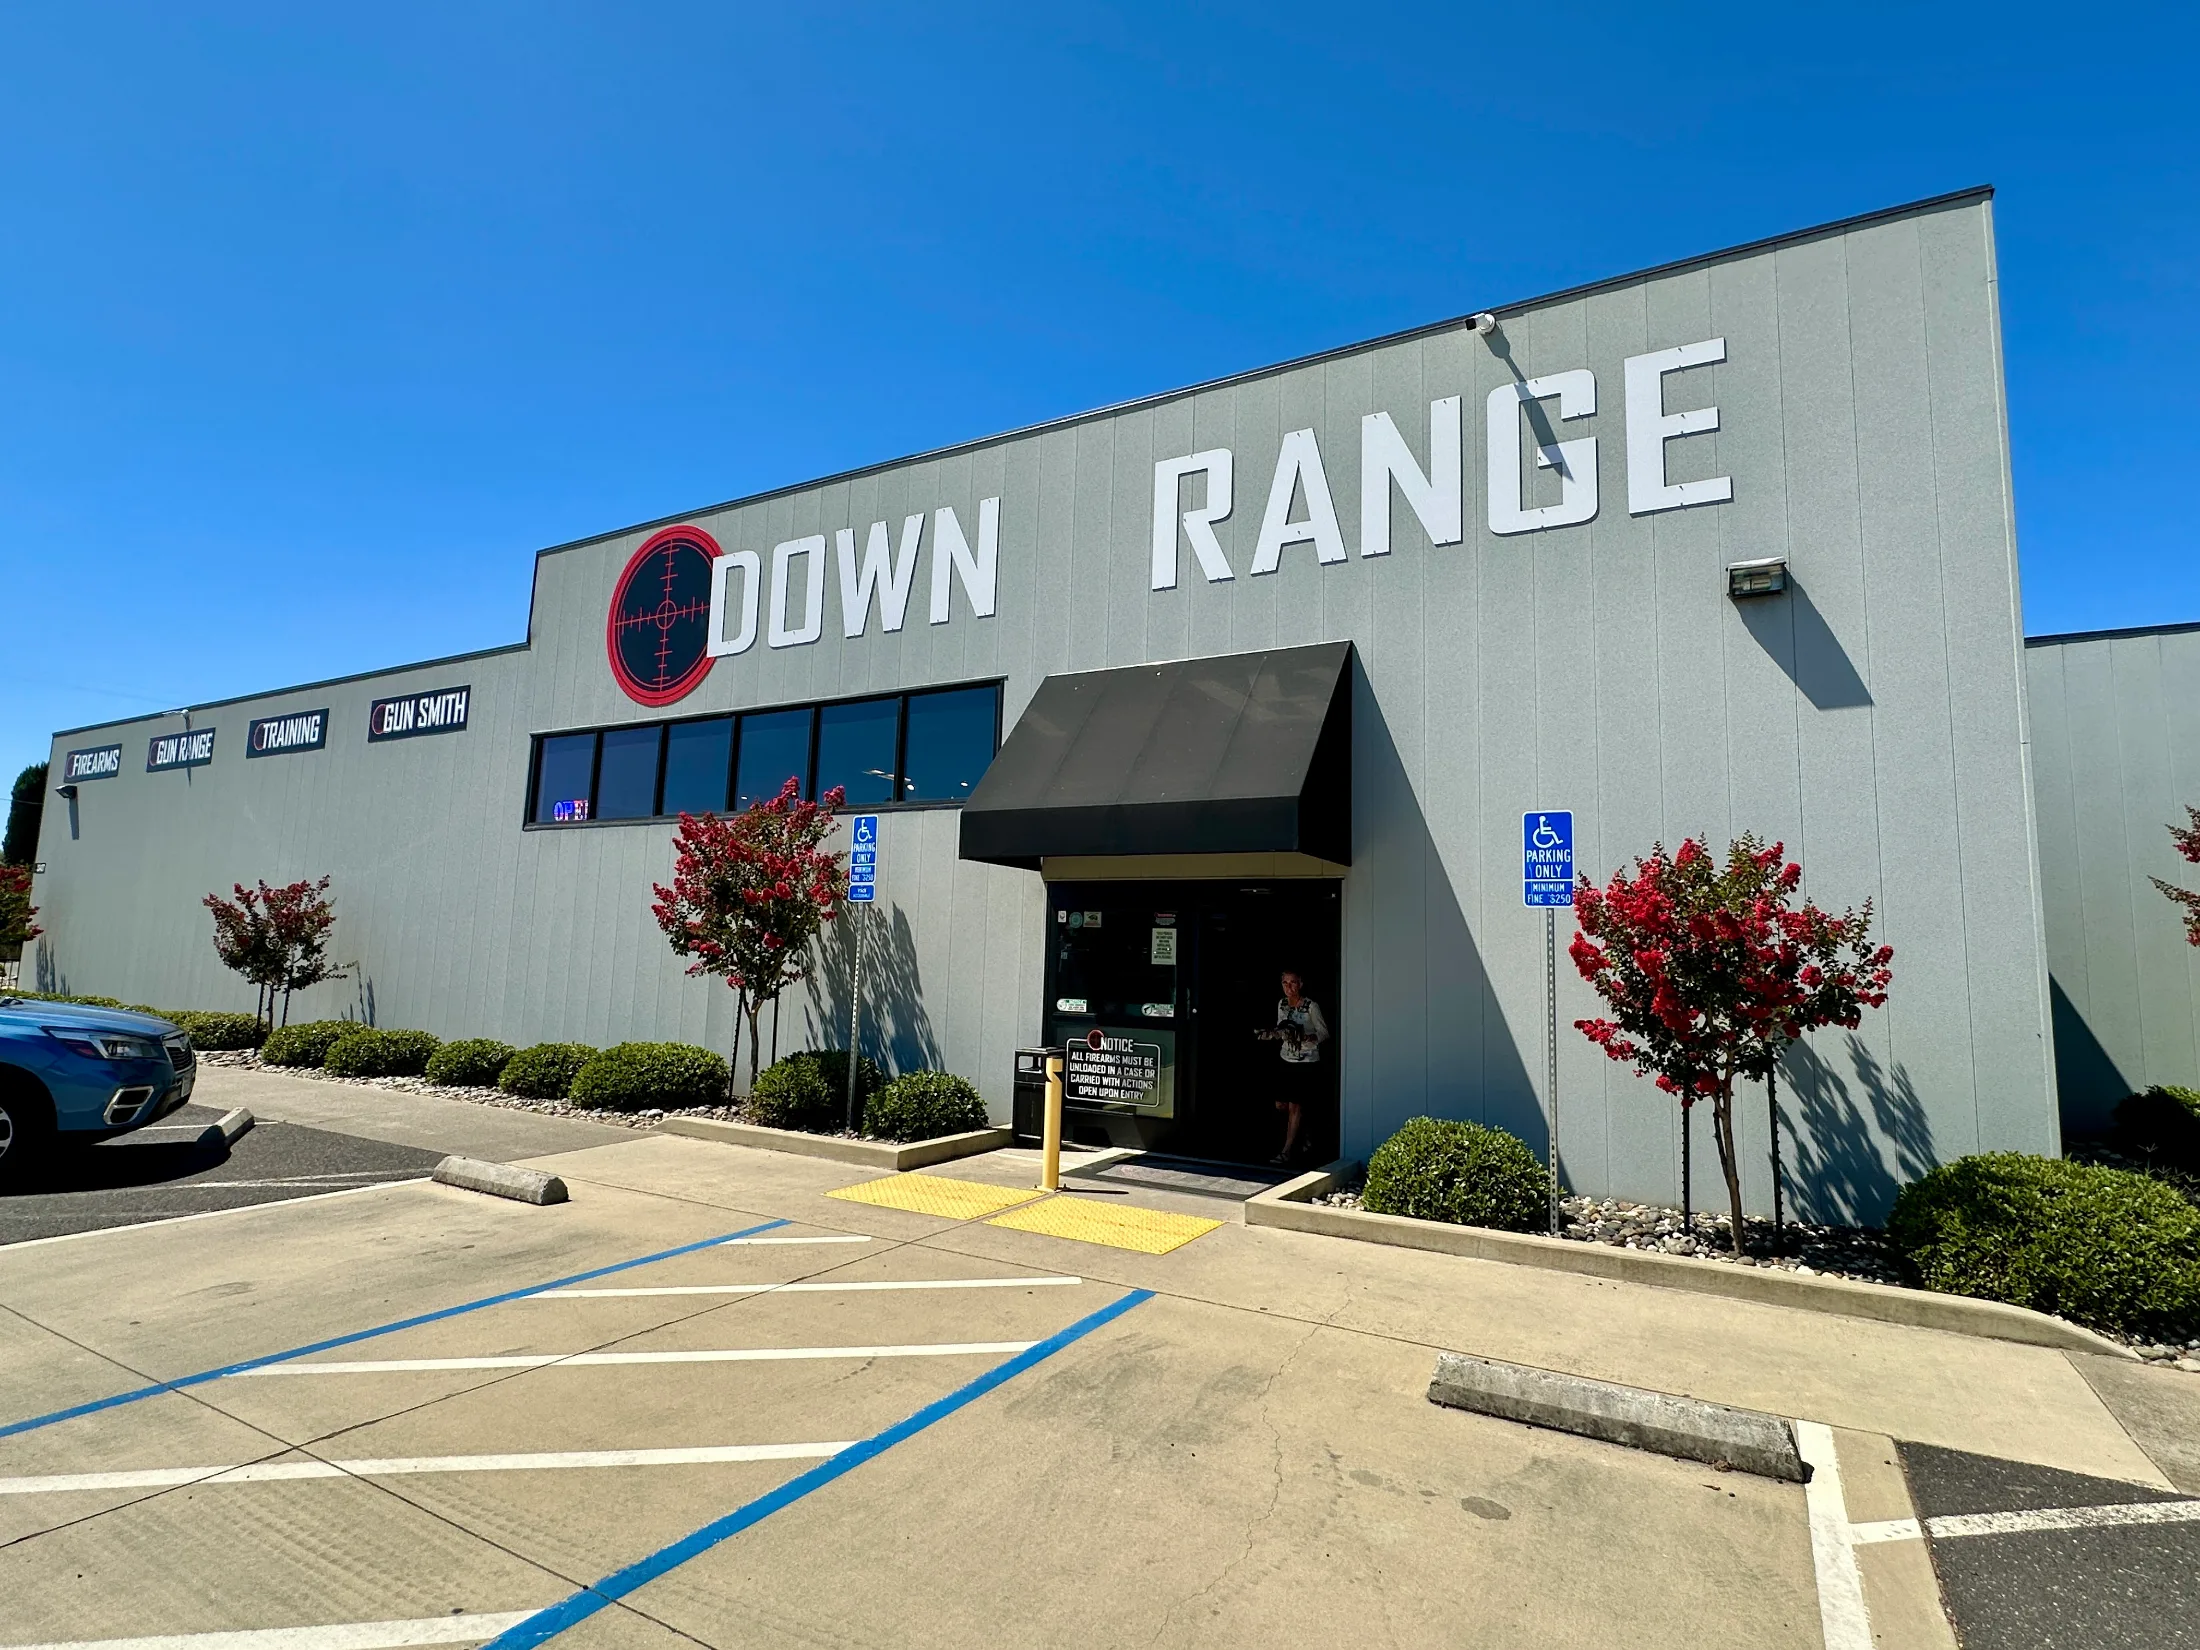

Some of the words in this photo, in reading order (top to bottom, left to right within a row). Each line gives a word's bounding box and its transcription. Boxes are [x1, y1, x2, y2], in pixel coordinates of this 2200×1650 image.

[707, 496, 999, 658] DOWN
[1151, 337, 1732, 591] RANGE
[383, 700, 415, 733] GUN
[417, 691, 467, 728] SMITH
[262, 715, 321, 749] TRAINING
[156, 740, 178, 764] GUN
[178, 733, 213, 761] RANGE
[72, 749, 120, 776] FIREARMS
[853, 843, 875, 852] PARKING
[857, 854, 871, 863] ONLY
[1526, 849, 1571, 863] PARKING
[1535, 864, 1562, 878] ONLY
[1532, 882, 1565, 892] MINIMUM
[1527, 893, 1543, 904] FINE
[1549, 893, 1571, 904] $250
[1100, 1036, 1134, 1053] NOTICE
[1071, 1051, 1084, 1061] ALL
[1085, 1052, 1120, 1064] FIREARMS
[1121, 1056, 1142, 1066] MUST
[1143, 1057, 1154, 1067] BE
[1069, 1062, 1106, 1074] UNLOADED
[1107, 1065, 1116, 1075] IN
[1116, 1066, 1122, 1076] A
[1123, 1067, 1143, 1077] CASE
[1144, 1068, 1155, 1078] OR
[1070, 1073, 1100, 1085] CARRIED
[1101, 1076, 1120, 1087] WITH
[1121, 1078, 1154, 1090] ACTIONS
[1078, 1085, 1098, 1096] OPEN
[1098, 1087, 1120, 1098] UPON
[1120, 1089, 1144, 1100] ENTRY
